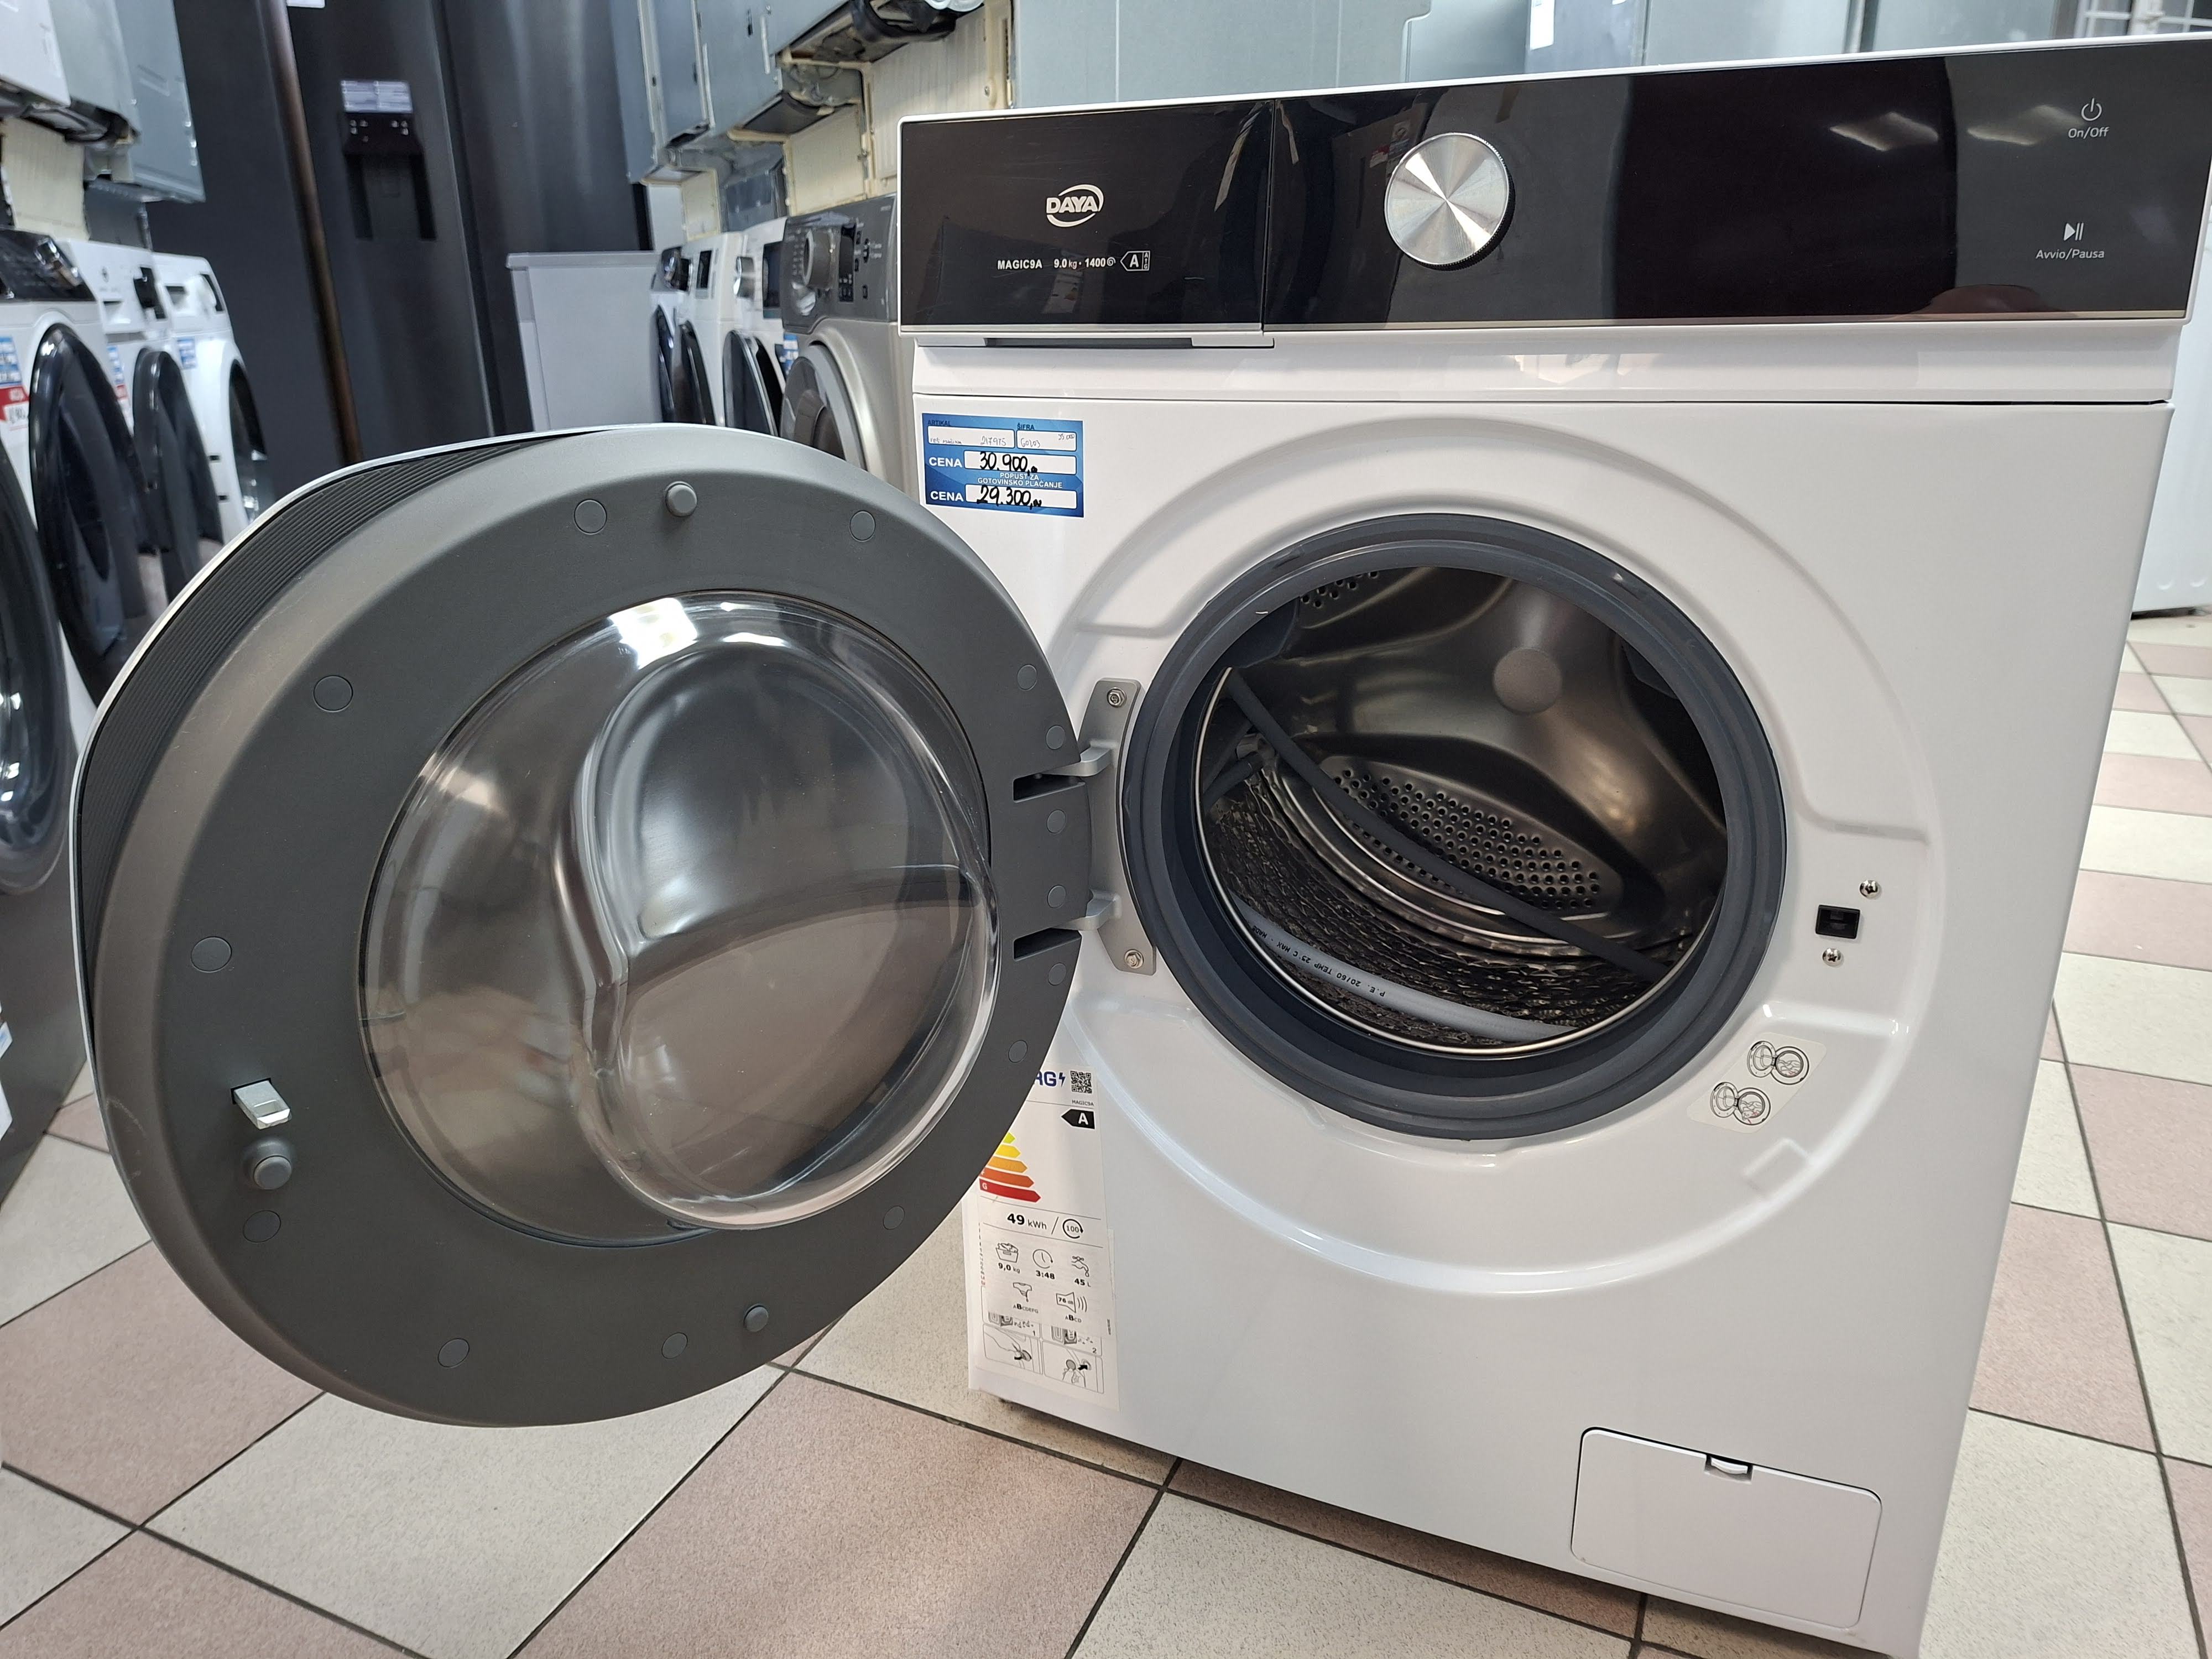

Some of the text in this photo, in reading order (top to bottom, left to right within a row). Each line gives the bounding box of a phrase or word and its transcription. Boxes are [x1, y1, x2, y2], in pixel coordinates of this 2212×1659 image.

[2068, 127, 2110, 139] On/Off
[1046, 196, 1098, 213] DAYA
[2036, 248, 2105, 260] Avvio/Pausa
[997, 257, 1105, 270] MAGIC9A 9.0 kg 1400
[1129, 254, 1139, 268] A
[928, 457, 963, 468] CENA
[978, 477, 1063, 488] GOTOVINSKO PLAĆANJE
[930, 491, 964, 502] CENA
[1276, 941, 1291, 953] MAX
[1313, 963, 1333, 975] TEMP
[1336, 972, 1361, 987] 20/60
[1078, 1112, 1089, 1125] A
[1006, 1213, 1025, 1225] 49
[1027, 1219, 1047, 1230] kWh
[1066, 1225, 1079, 1233] 100
[998, 1262, 1020, 1274] 9,0 kg
[1036, 1270, 1055, 1280] 3:48
